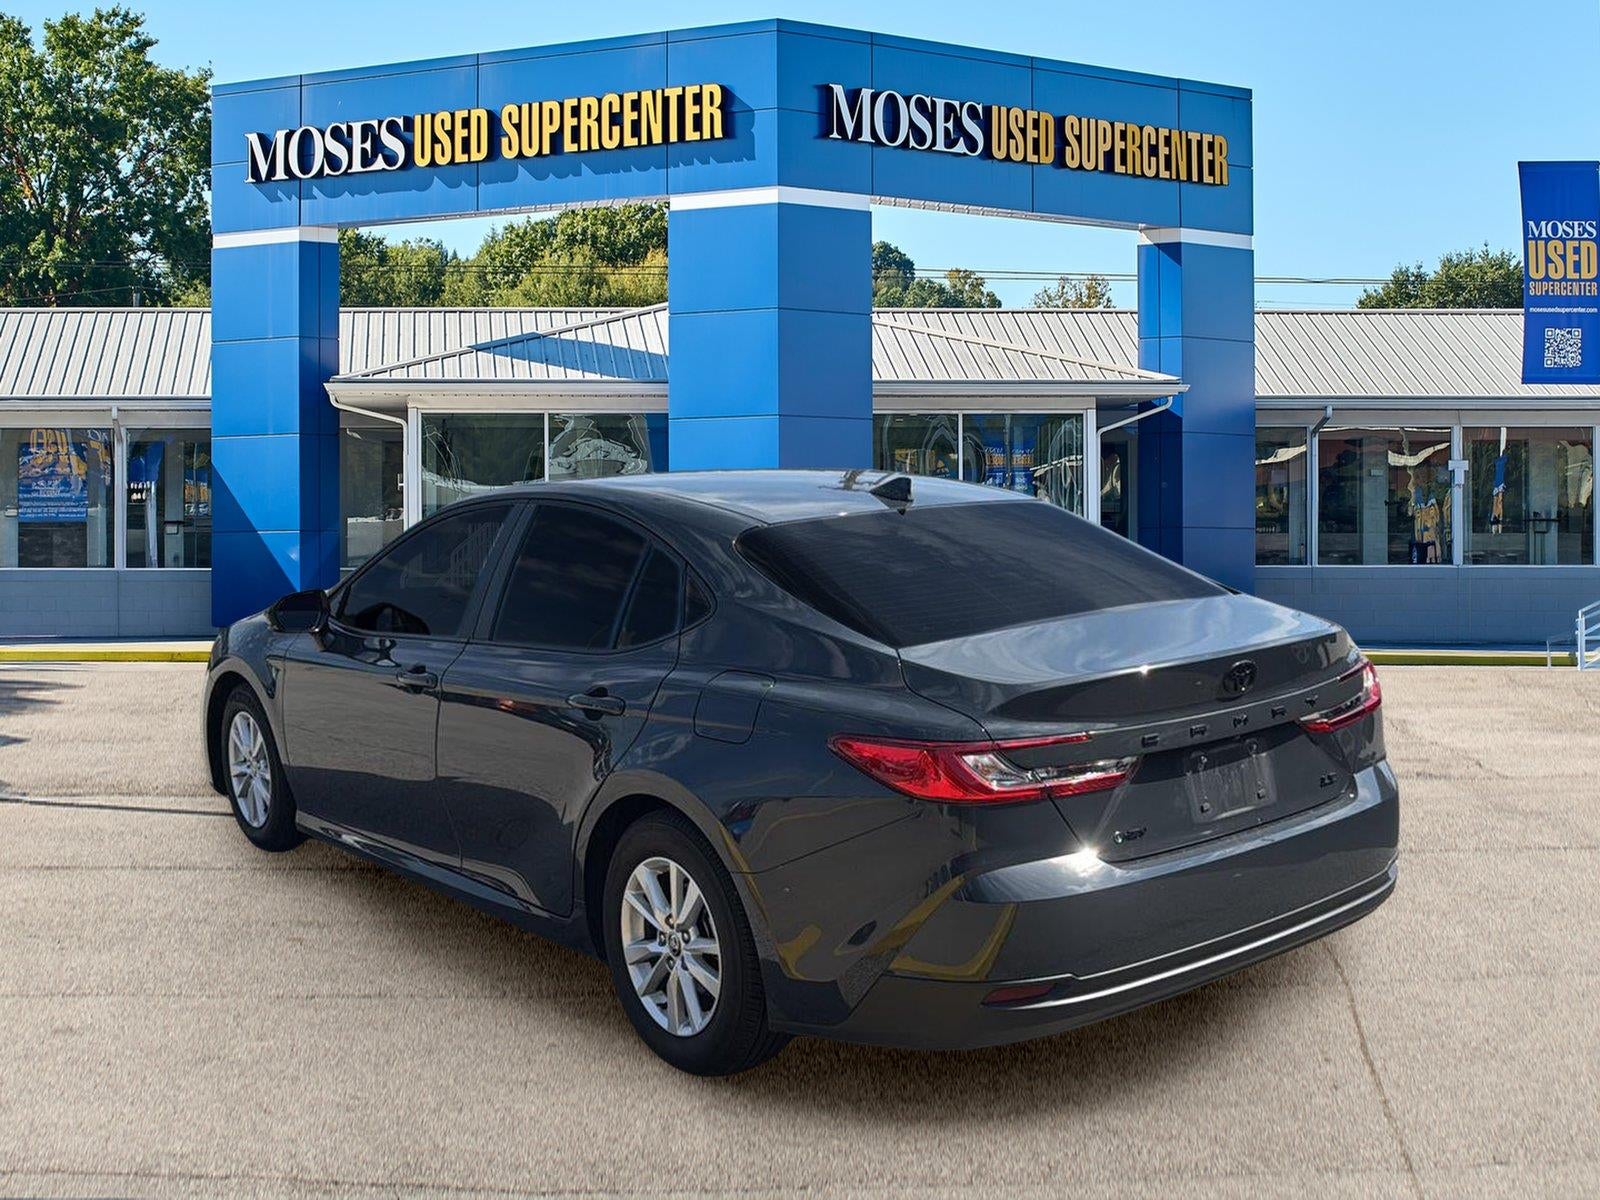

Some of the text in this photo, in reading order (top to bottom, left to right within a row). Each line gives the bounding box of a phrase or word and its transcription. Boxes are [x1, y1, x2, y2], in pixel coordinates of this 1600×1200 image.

[244, 83, 724, 184] MOSES USED SUPERCENTER
[828, 83, 1229, 186] MOSES USED SUPERCENTER
[1527, 221, 1597, 238] MOSES
[1529, 241, 1597, 279] USED
[1529, 282, 1597, 296] SUPERCENTER
